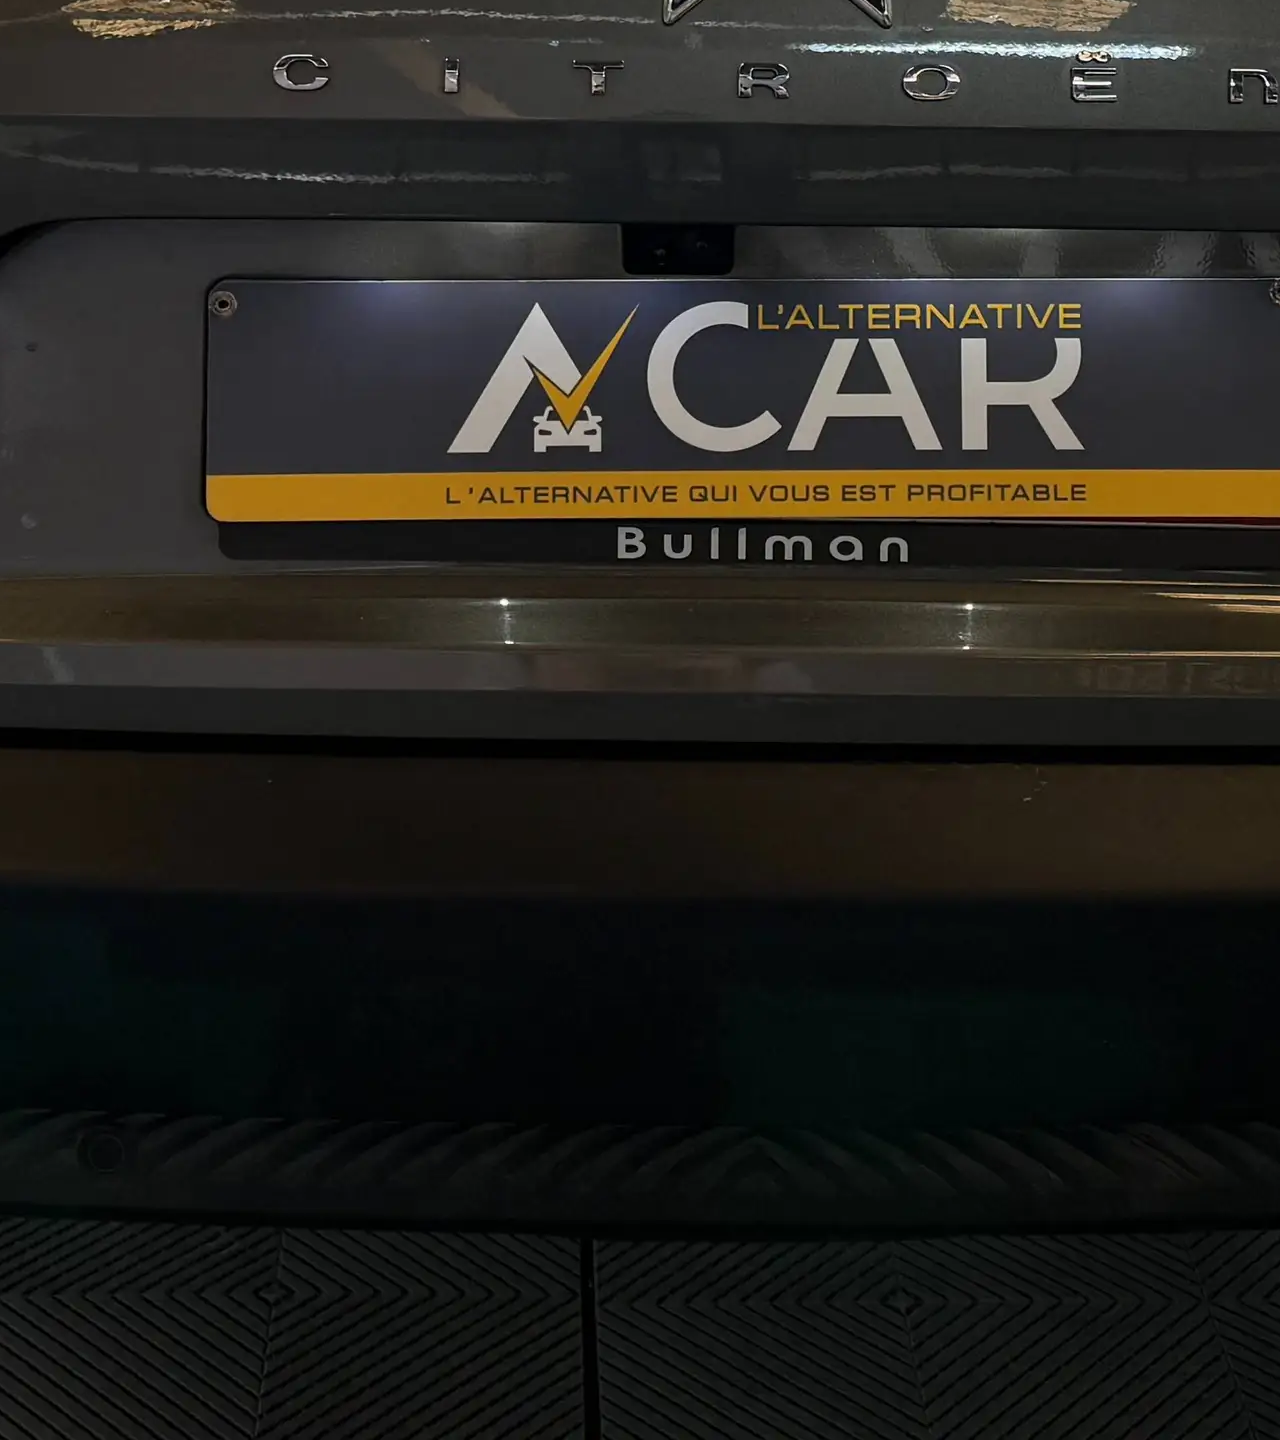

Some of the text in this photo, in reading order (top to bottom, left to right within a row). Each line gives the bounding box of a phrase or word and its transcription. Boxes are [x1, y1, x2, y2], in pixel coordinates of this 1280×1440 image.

[757, 303, 1082, 330] L'ALTERNATIVE
[688, 484, 738, 503] QUI
[748, 484, 830, 503] VOUS
[841, 484, 897, 502] EST
[907, 483, 1087, 503] PROFITABLE
[616, 525, 910, 564] Bullman
